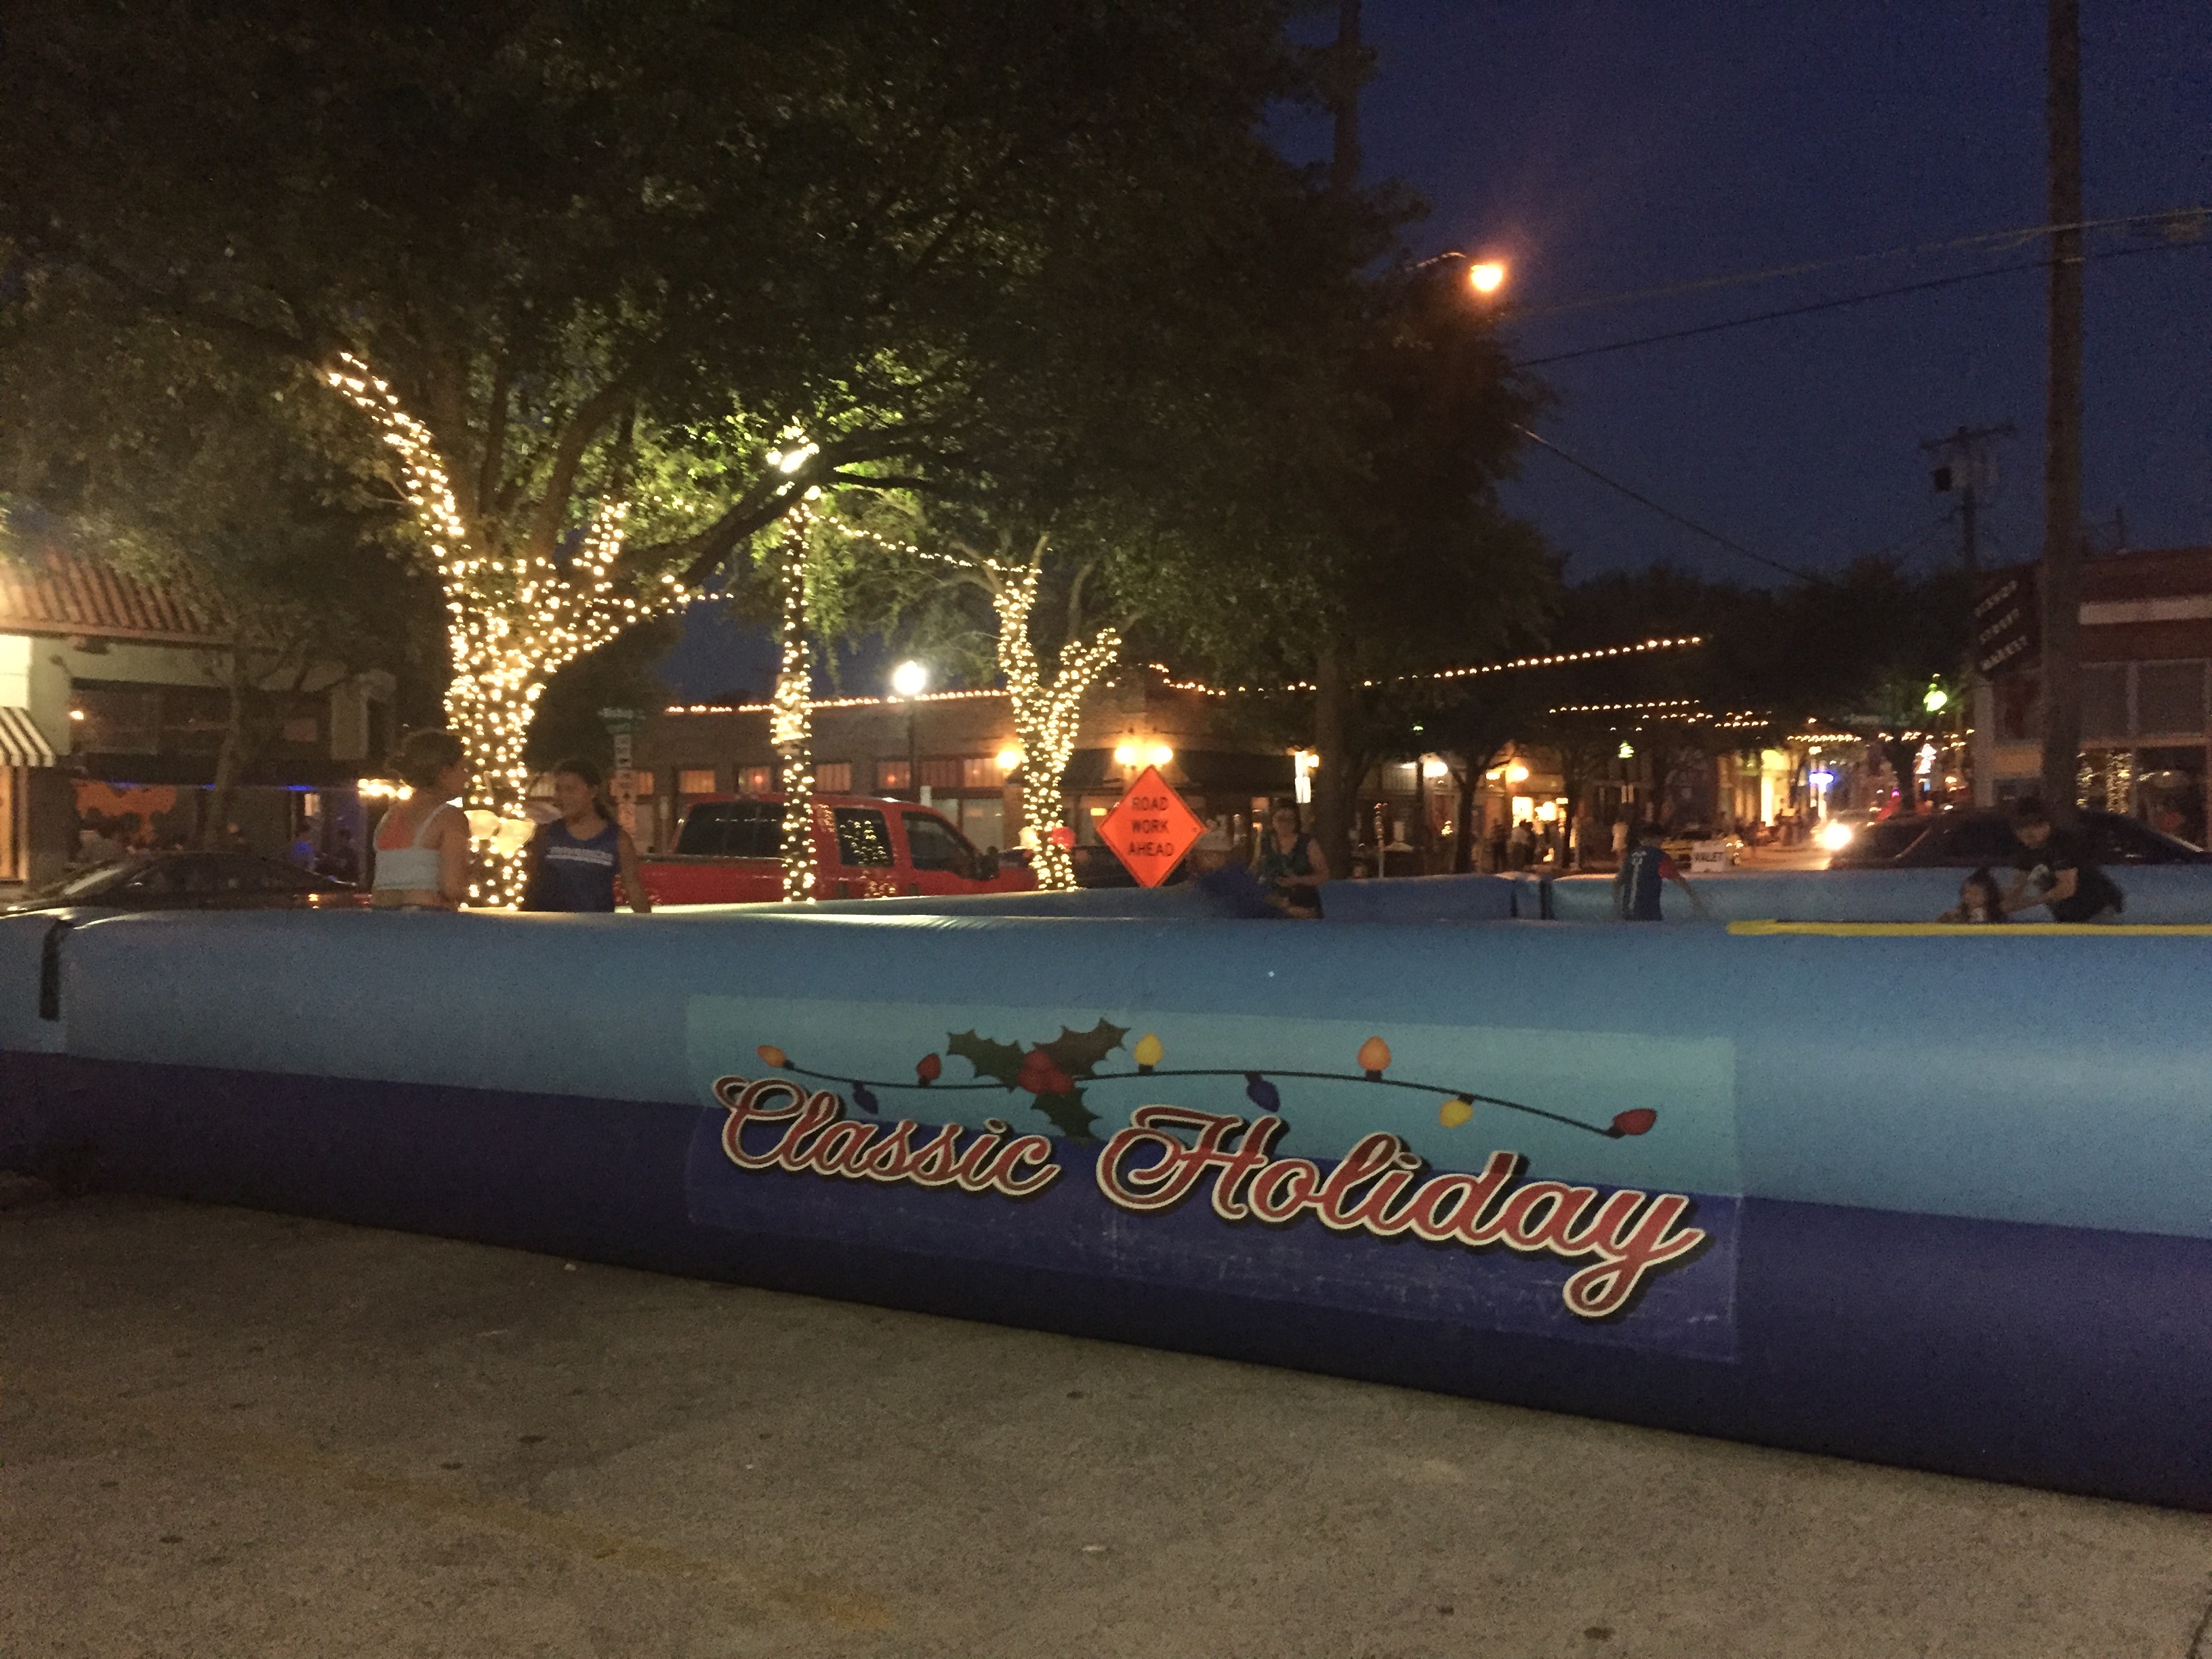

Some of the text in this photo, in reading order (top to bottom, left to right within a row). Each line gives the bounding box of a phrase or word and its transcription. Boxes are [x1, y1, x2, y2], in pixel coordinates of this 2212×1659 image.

[1131, 796, 1169, 811] ROAD
[1131, 819, 1169, 834] WORK
[1128, 842, 1174, 857] AHEAD
[713, 1076, 1707, 1318] Classic Holiday
